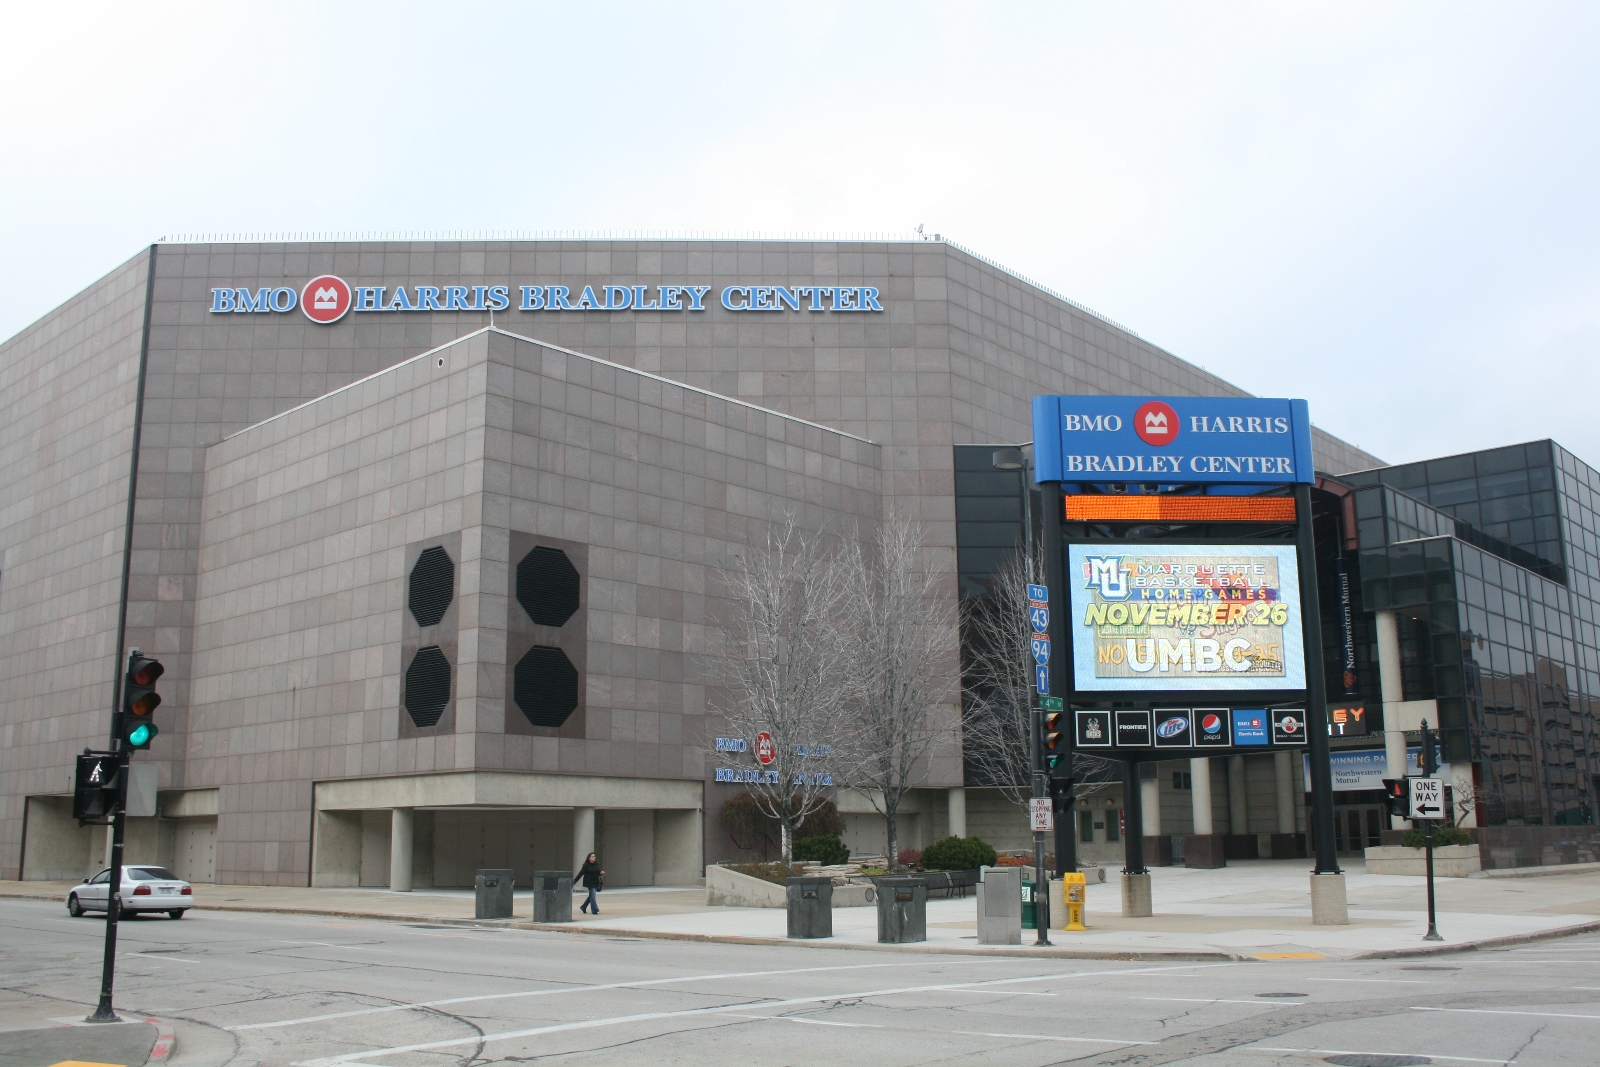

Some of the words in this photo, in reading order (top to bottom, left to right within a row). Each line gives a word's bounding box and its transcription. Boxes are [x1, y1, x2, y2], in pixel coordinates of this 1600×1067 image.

[209, 287, 298, 313] BMO
[354, 286, 510, 311] HARRIS
[518, 285, 711, 311] BRADLEY
[720, 285, 884, 312] CENTER
[1064, 414, 1123, 432] BMO
[1190, 416, 1289, 434] HARRIS
[1066, 455, 1184, 473] BRADLEY
[1190, 456, 1294, 474] CENTER
[1138, 563, 1266, 577] MARQUETTE
[1135, 576, 1271, 588] BASKETBALL
[1339, 573, 1349, 605] Mutual
[1033, 587, 1043, 598] TO
[1141, 588, 1194, 600] HOME
[1204, 588, 1267, 600] GAMES
[1031, 609, 1047, 628] 43
[1084, 603, 1248, 626] NOVEMBER
[1252, 603, 1289, 626] 26
[1344, 606, 1355, 669] Northwestern
[1032, 641, 1049, 660] 94
[1126, 637, 1253, 673] UMBC
[1164, 722, 1184, 736] Lite
[1203, 733, 1221, 741] pepsi
[715, 737, 748, 753] BMO
[1335, 769, 1382, 778] Northwestern
[1336, 776, 1361, 784] Mutual
[1416, 781, 1437, 791] ONE
[1415, 792, 1439, 801] WAY
